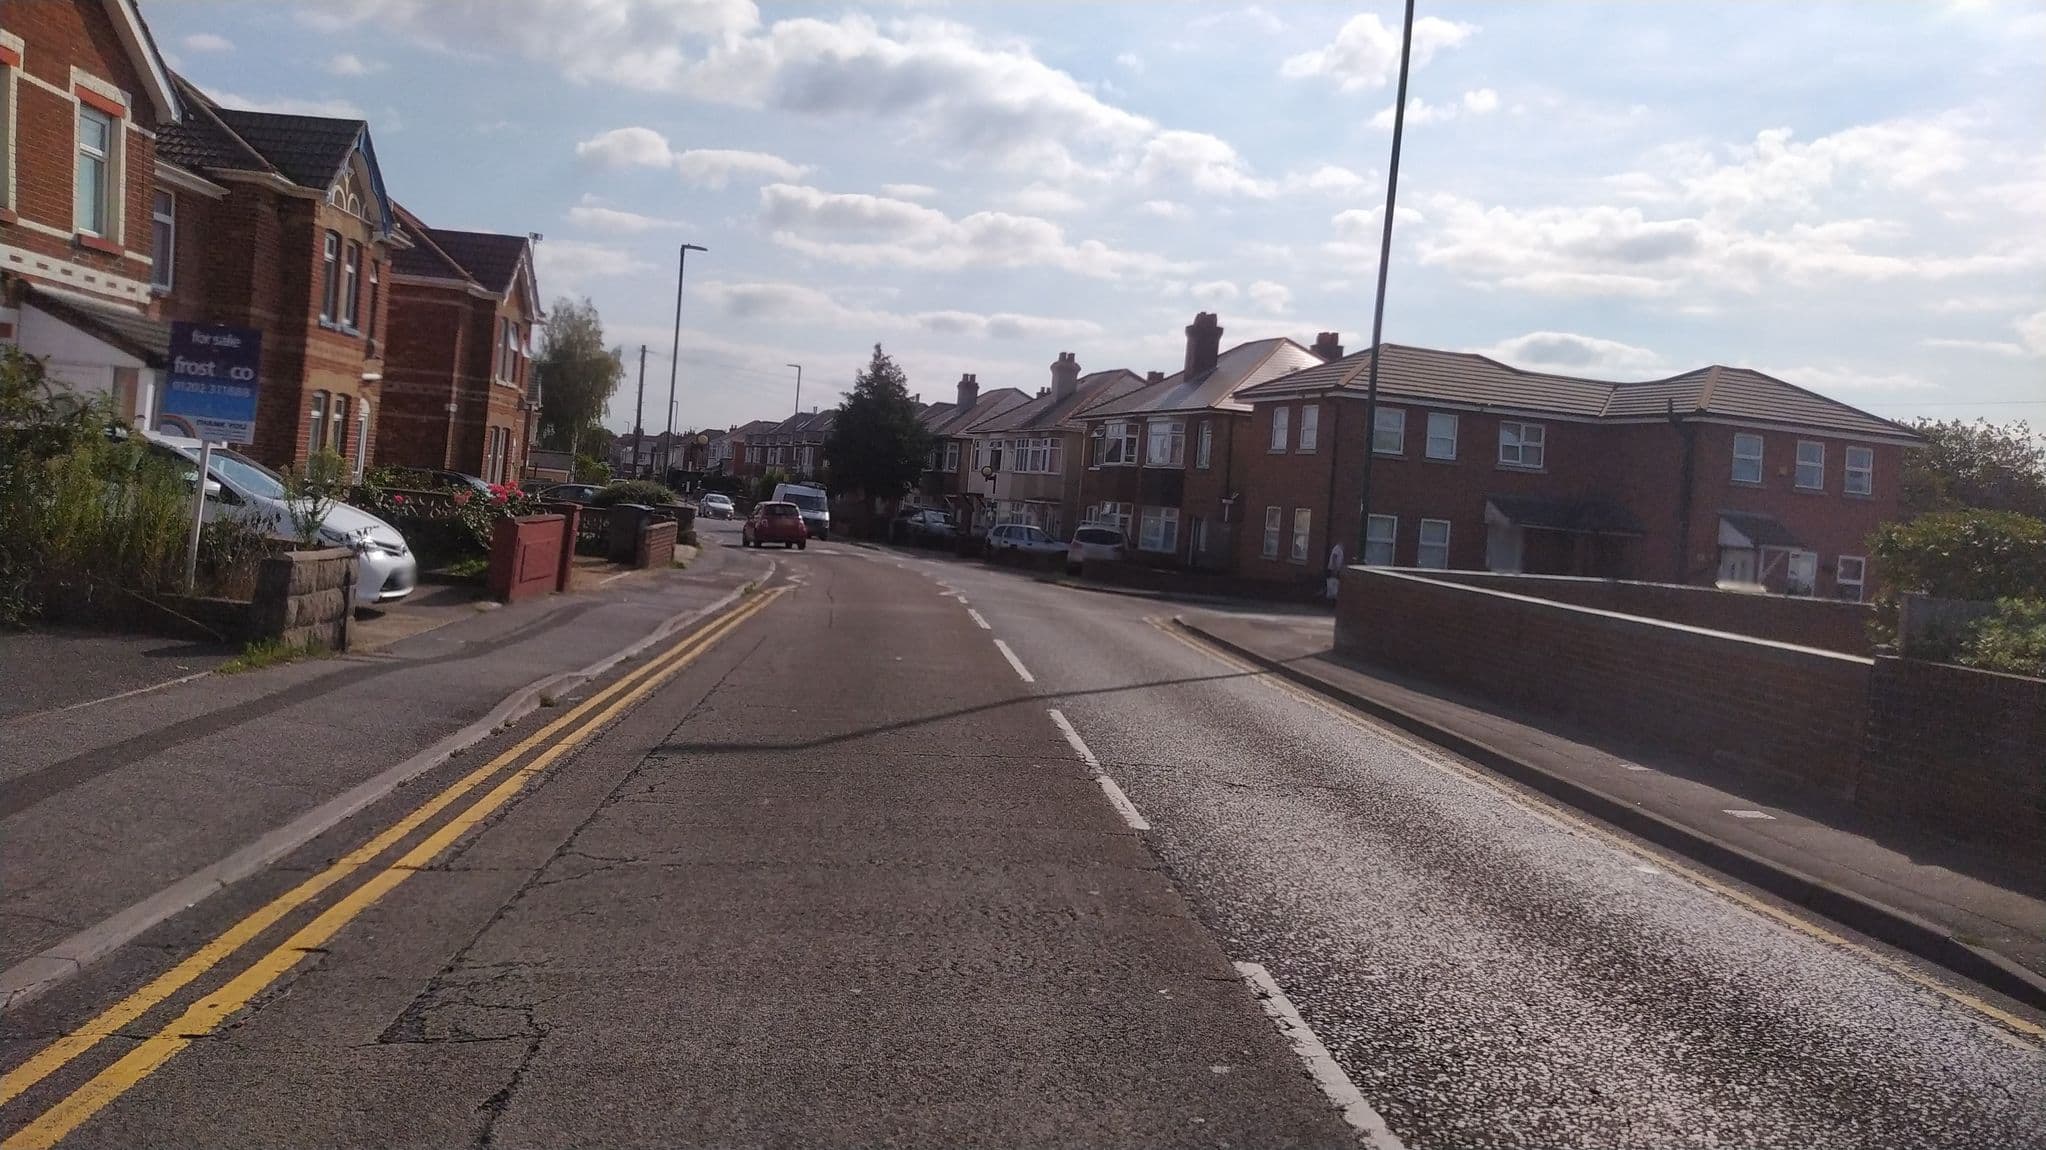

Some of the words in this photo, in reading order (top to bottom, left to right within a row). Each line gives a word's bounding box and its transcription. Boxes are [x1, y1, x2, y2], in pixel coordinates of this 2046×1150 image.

[192, 330, 211, 344] for
[211, 334, 241, 348] sale
[174, 355, 216, 376] frost
[230, 366, 255, 381] co
